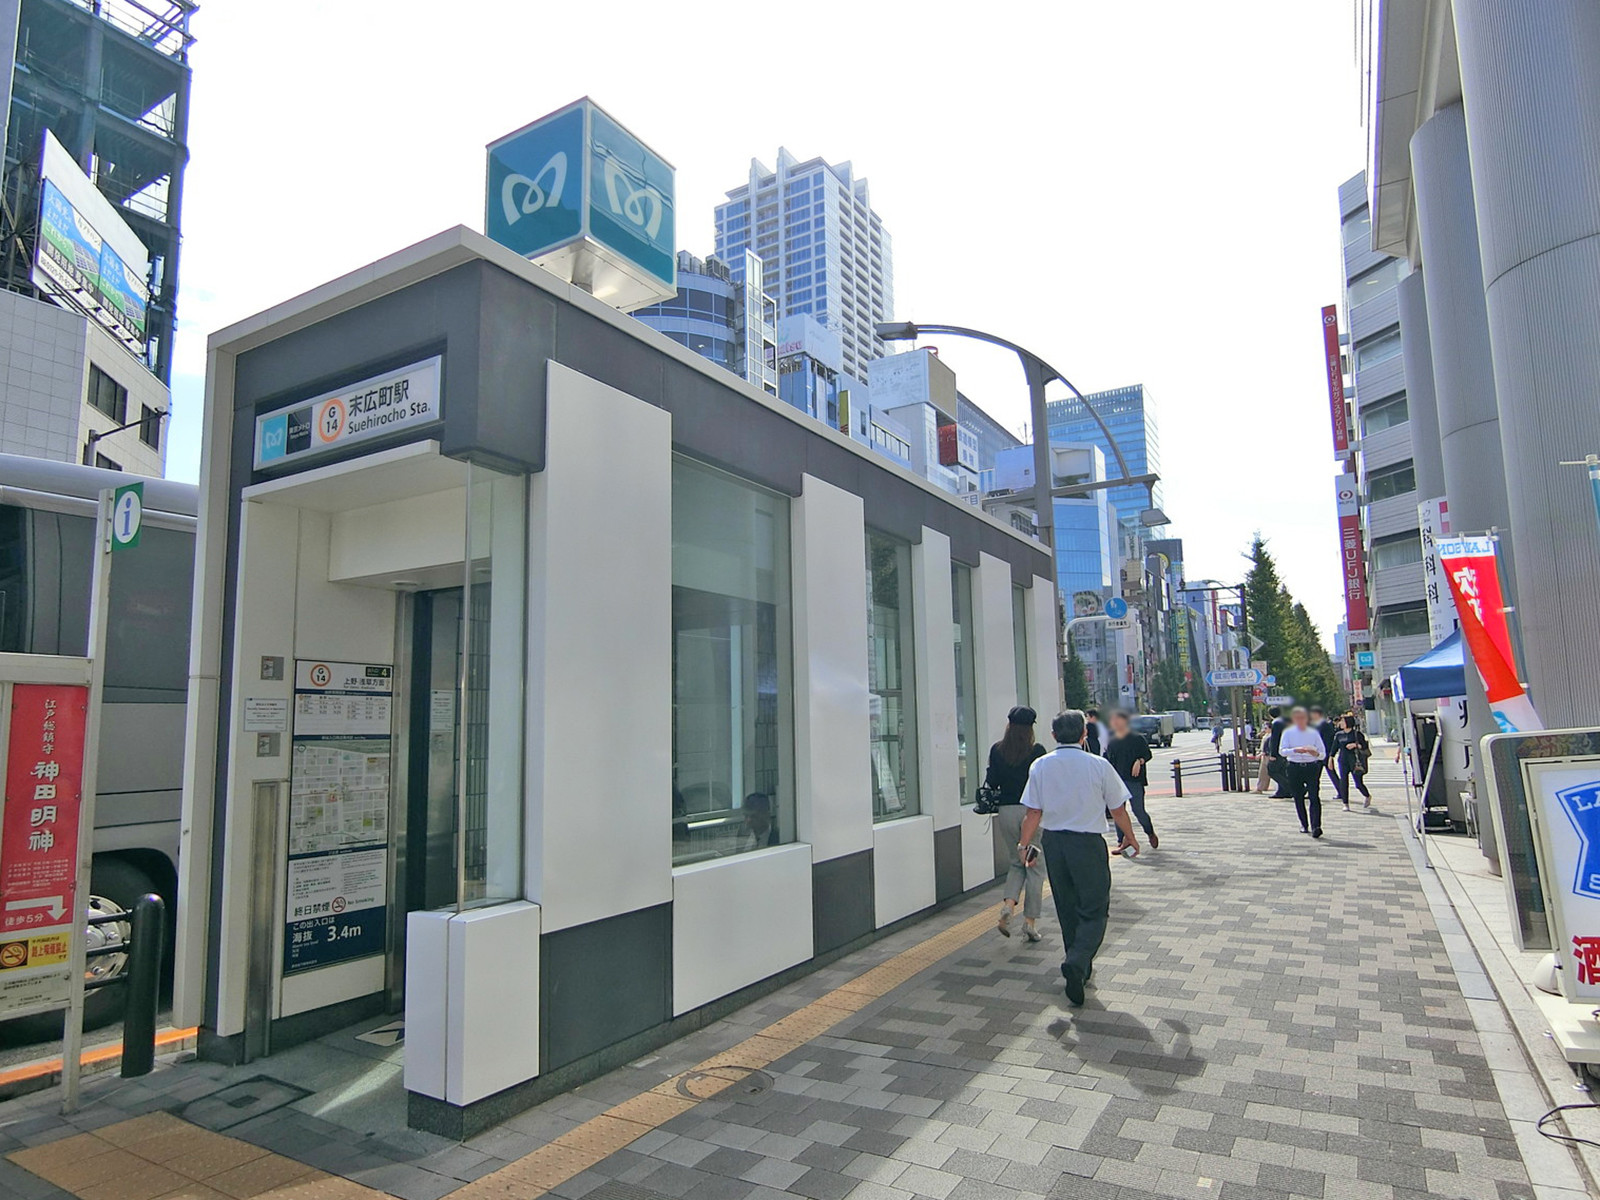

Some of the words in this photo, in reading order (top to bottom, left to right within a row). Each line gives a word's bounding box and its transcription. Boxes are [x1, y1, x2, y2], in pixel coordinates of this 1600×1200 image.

[349, 379, 409, 416] 末広町駅
[328, 406, 337, 418] G
[348, 409, 407, 435] Suehirocho
[410, 402, 431, 417] Sta.
[326, 421, 338, 434] 14
[1343, 527, 1361, 600] 三菱UFJ銀行
[318, 667, 324, 675] G
[381, 668, 388, 677] 4
[28, 760, 60, 853] 神田明神
[294, 902, 330, 917] 終日禁煙
[5, 913, 44, 927] 徒歩5分
[293, 916, 335, 931] この出入口は
[327, 925, 361, 942] 3.4m
